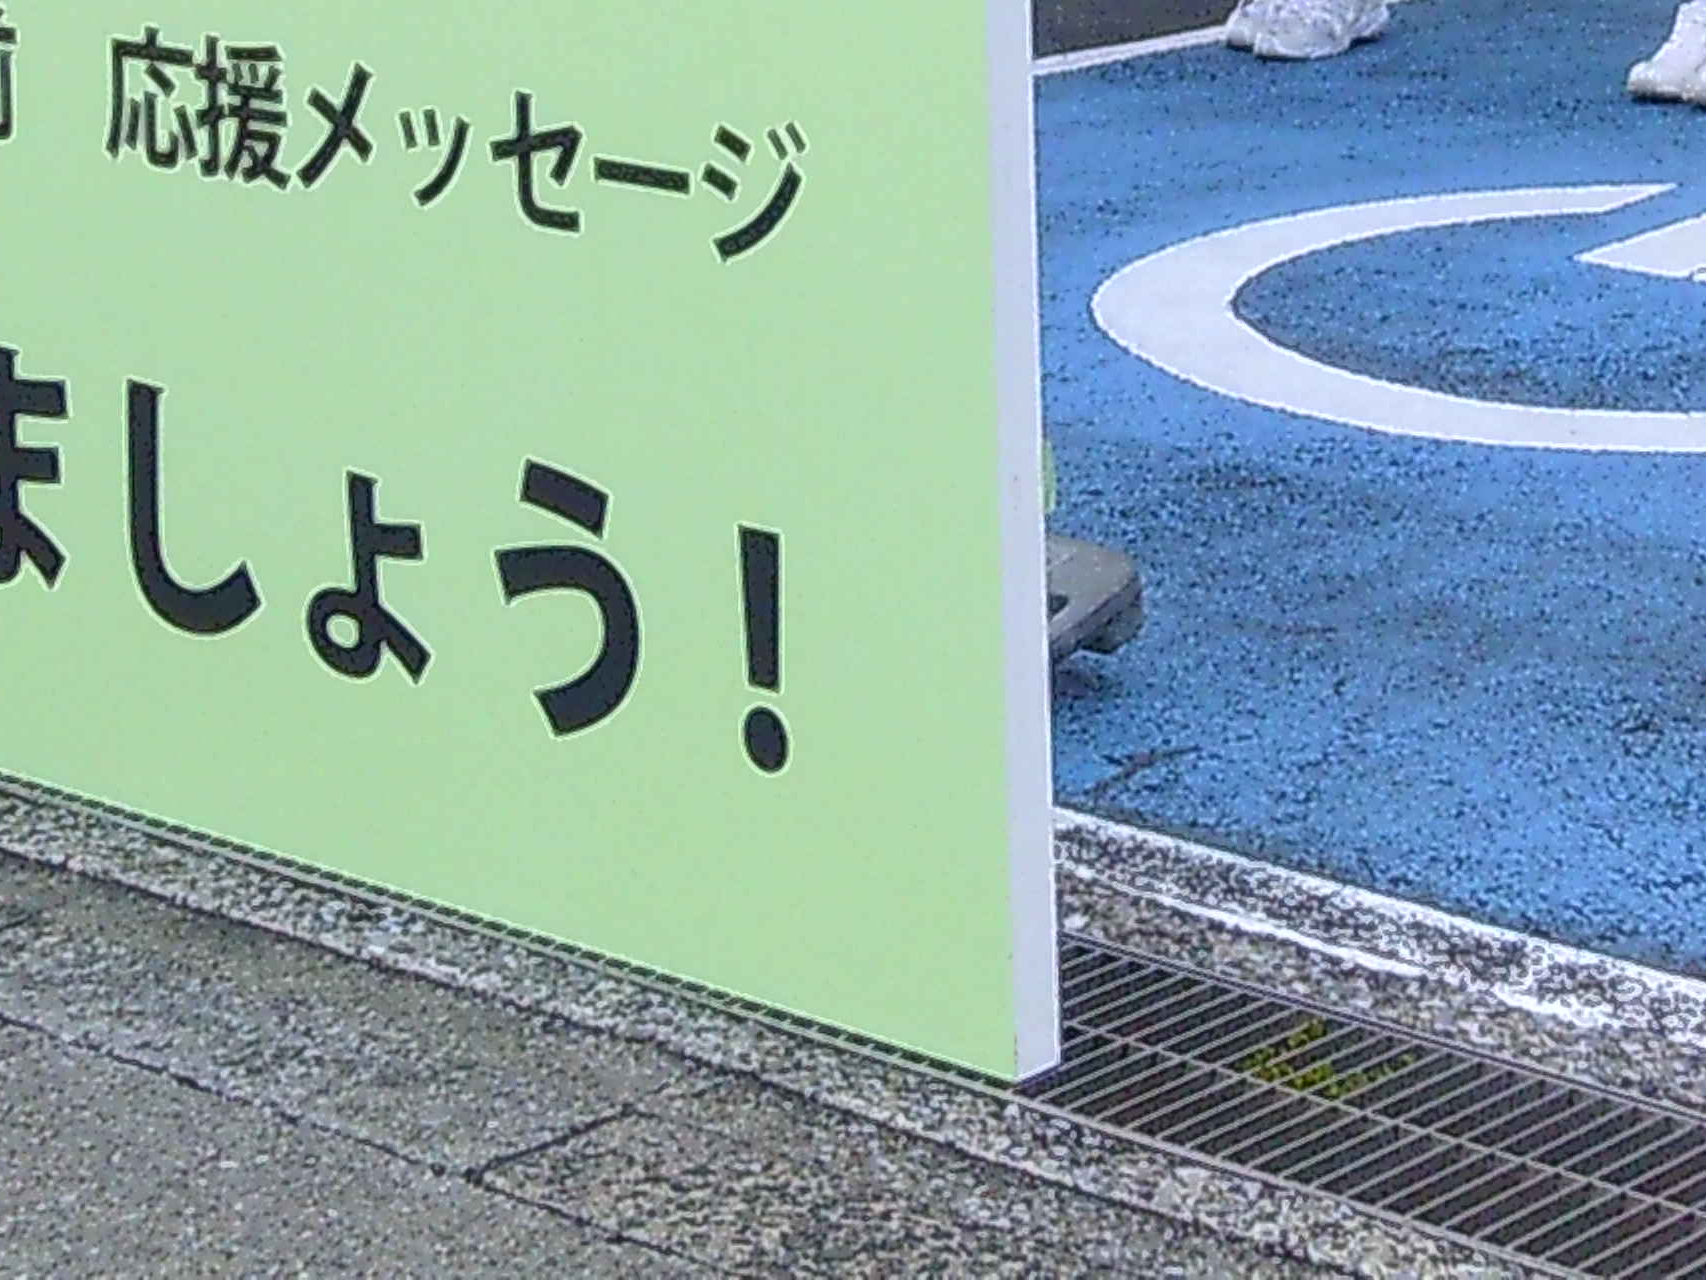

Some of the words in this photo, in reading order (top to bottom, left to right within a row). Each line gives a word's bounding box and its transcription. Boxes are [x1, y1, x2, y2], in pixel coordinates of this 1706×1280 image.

[105, 26, 807, 262] 応援メッセージ
